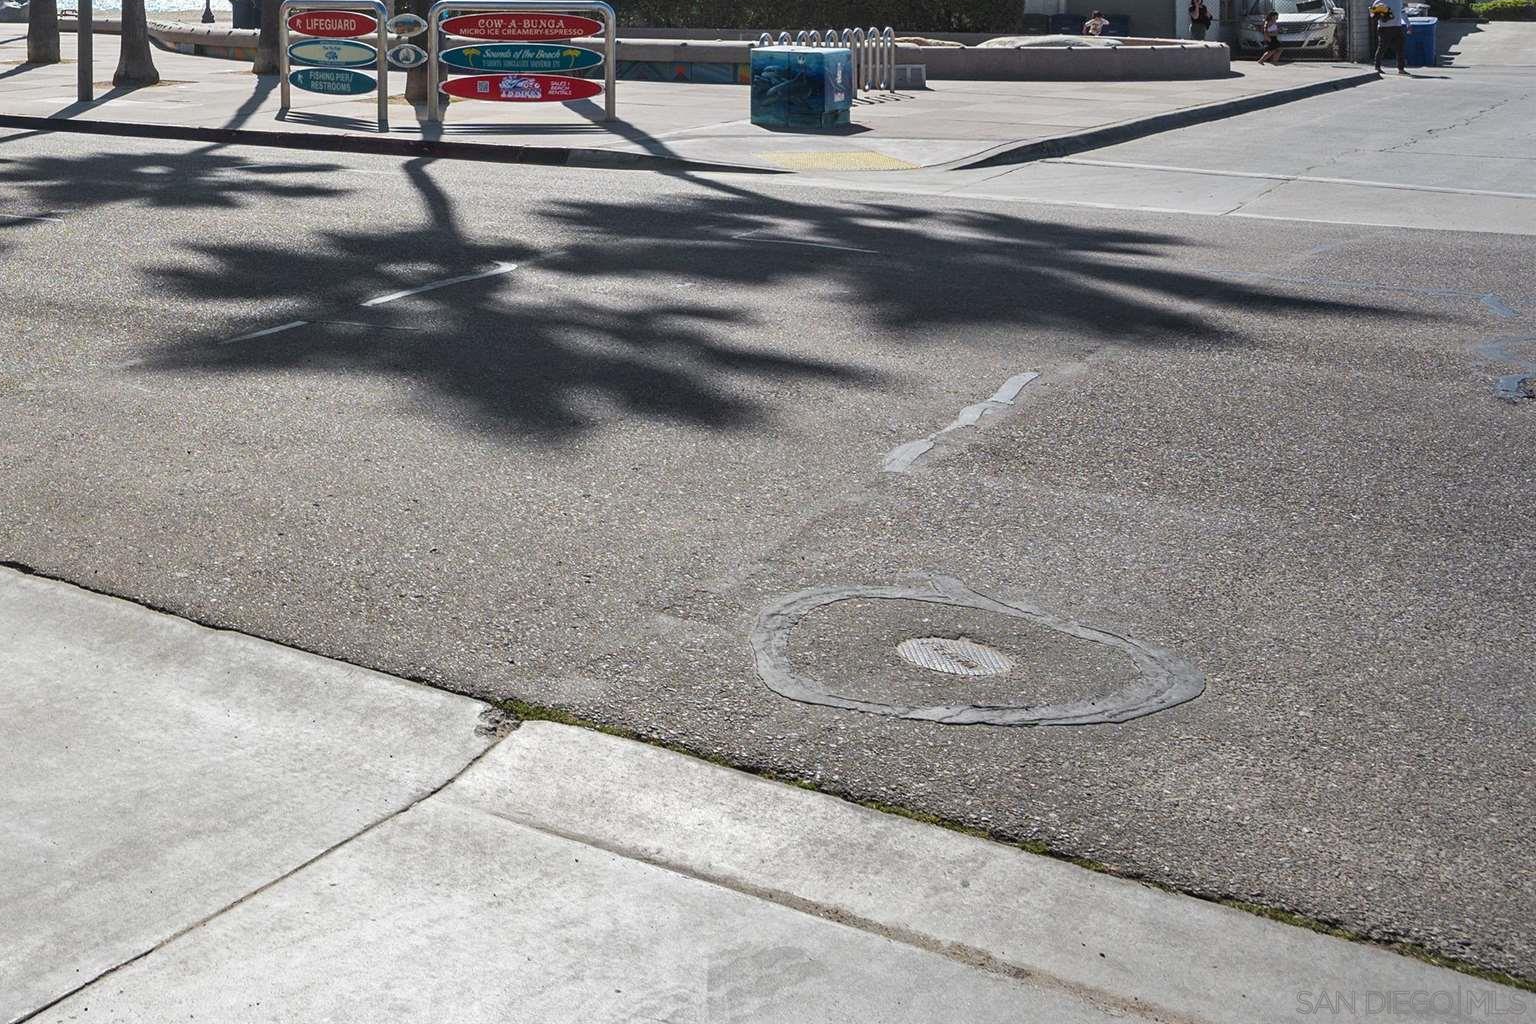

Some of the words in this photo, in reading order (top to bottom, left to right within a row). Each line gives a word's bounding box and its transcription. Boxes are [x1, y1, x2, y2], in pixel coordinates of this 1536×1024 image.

[306, 18, 357, 31] LIFEGUARD
[478, 19, 565, 28] COW-A-BUNGA
[487, 28, 499, 36] ICE
[483, 49, 512, 58] Sounds
[513, 49, 523, 60] of
[522, 49, 535, 59] the
[536, 49, 560, 59] Beach
[309, 71, 335, 81] FISHING
[310, 81, 352, 92] RESTROOMS
